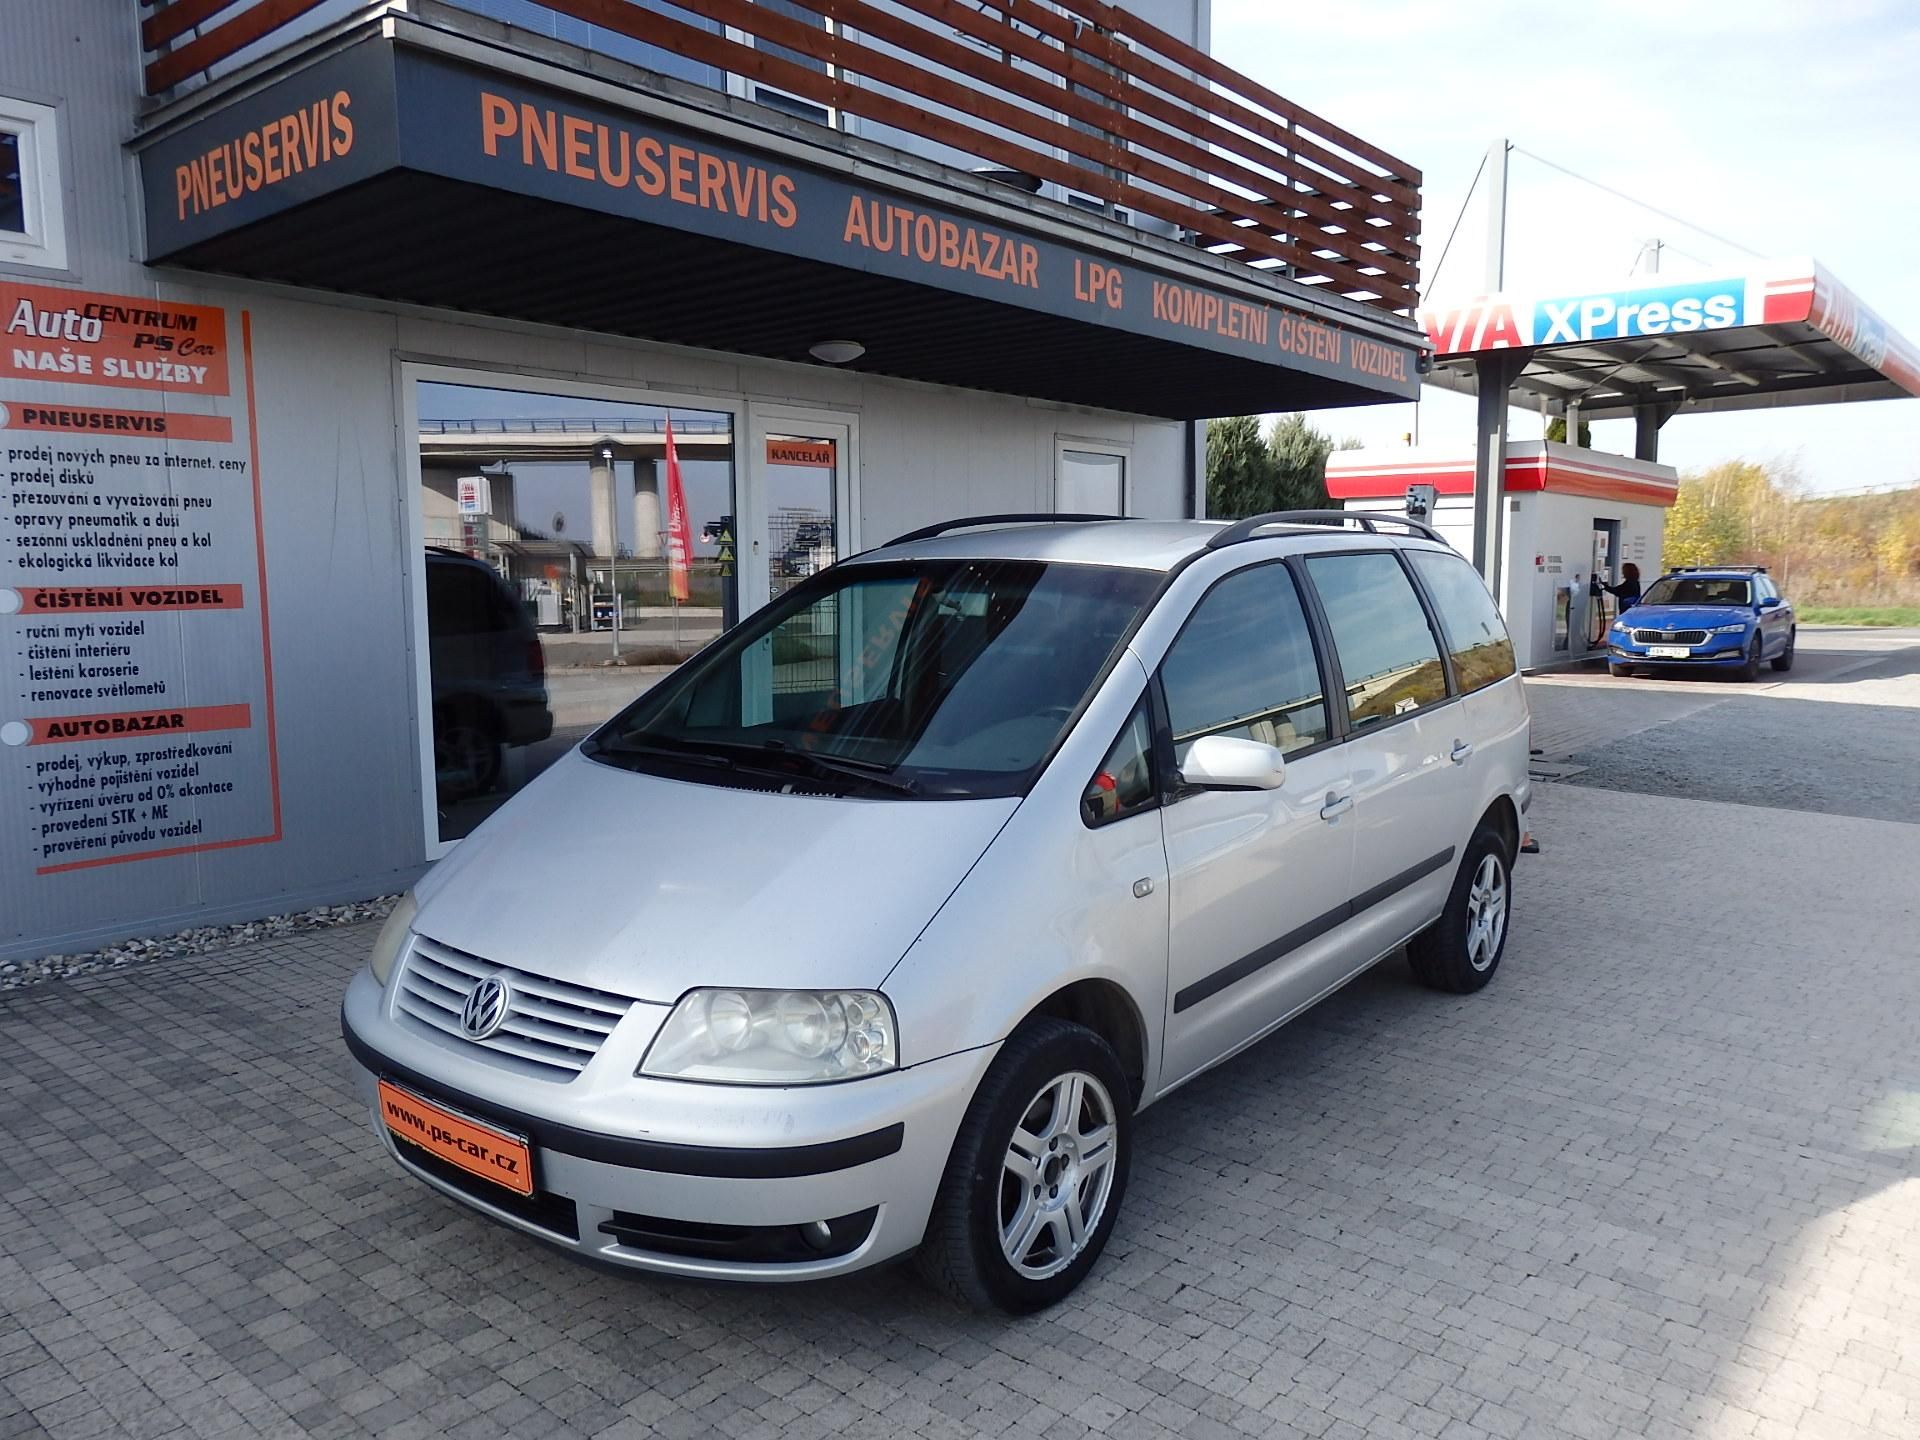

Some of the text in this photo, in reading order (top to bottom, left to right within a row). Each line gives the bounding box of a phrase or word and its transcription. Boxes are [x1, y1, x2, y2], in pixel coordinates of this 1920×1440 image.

[175, 90, 354, 221] PNEUSERVIS
[480, 92, 1408, 382] PNEUSERVIS AUTOBAZAR LPG KOMPLETNÍ ČIŠTĚNÍ VOZIDEL
[7, 298, 197, 343] Auto CENTRUM
[1541, 293, 1737, 345] XPress
[133, 333, 216, 357] PS Car
[13, 347, 208, 385] NAŠE SLUŽBY
[23, 409, 167, 433] PNEUSERVIS
[8, 445, 53, 465] prodej
[57, 448, 105, 467] nových
[109, 454, 140, 468] pneu
[145, 456, 160, 466] za
[219, 460, 246, 474] ceny
[11, 467, 55, 488] prodej
[13, 490, 212, 511] přezouvání a vyvažování pneu
[15, 515, 63, 530] opravy
[68, 511, 138, 530] pneumatik
[143, 517, 151, 527] a
[17, 531, 212, 550] sezónní uskladnění pneu a kol
[18, 552, 178, 572] ekologická likvidace kol
[34, 588, 224, 608] ČIŠTĚNÍ VOZIDEL
[26, 624, 60, 639] ruční
[99, 620, 145, 636] vozidel
[28, 642, 131, 660] čištění interiéru
[29, 661, 140, 681] leštění karoserie
[31, 688, 93, 702] renovace
[47, 713, 184, 738] AUTOBAZAR
[135, 741, 232, 765] zprostředkování
[38, 761, 199, 797] výhodné pojištění vozidel
[98, 792, 134, 807] úvěru
[138, 786, 153, 801] od
[157, 784, 175, 800] 0%
[179, 782, 233, 797] akontace
[41, 813, 108, 838] provedení
[111, 808, 137, 825] STK
[151, 804, 169, 820] ME
[43, 819, 202, 859] prověření původu vozidel
[386, 1100, 519, 1175] www.ps-car.cz
